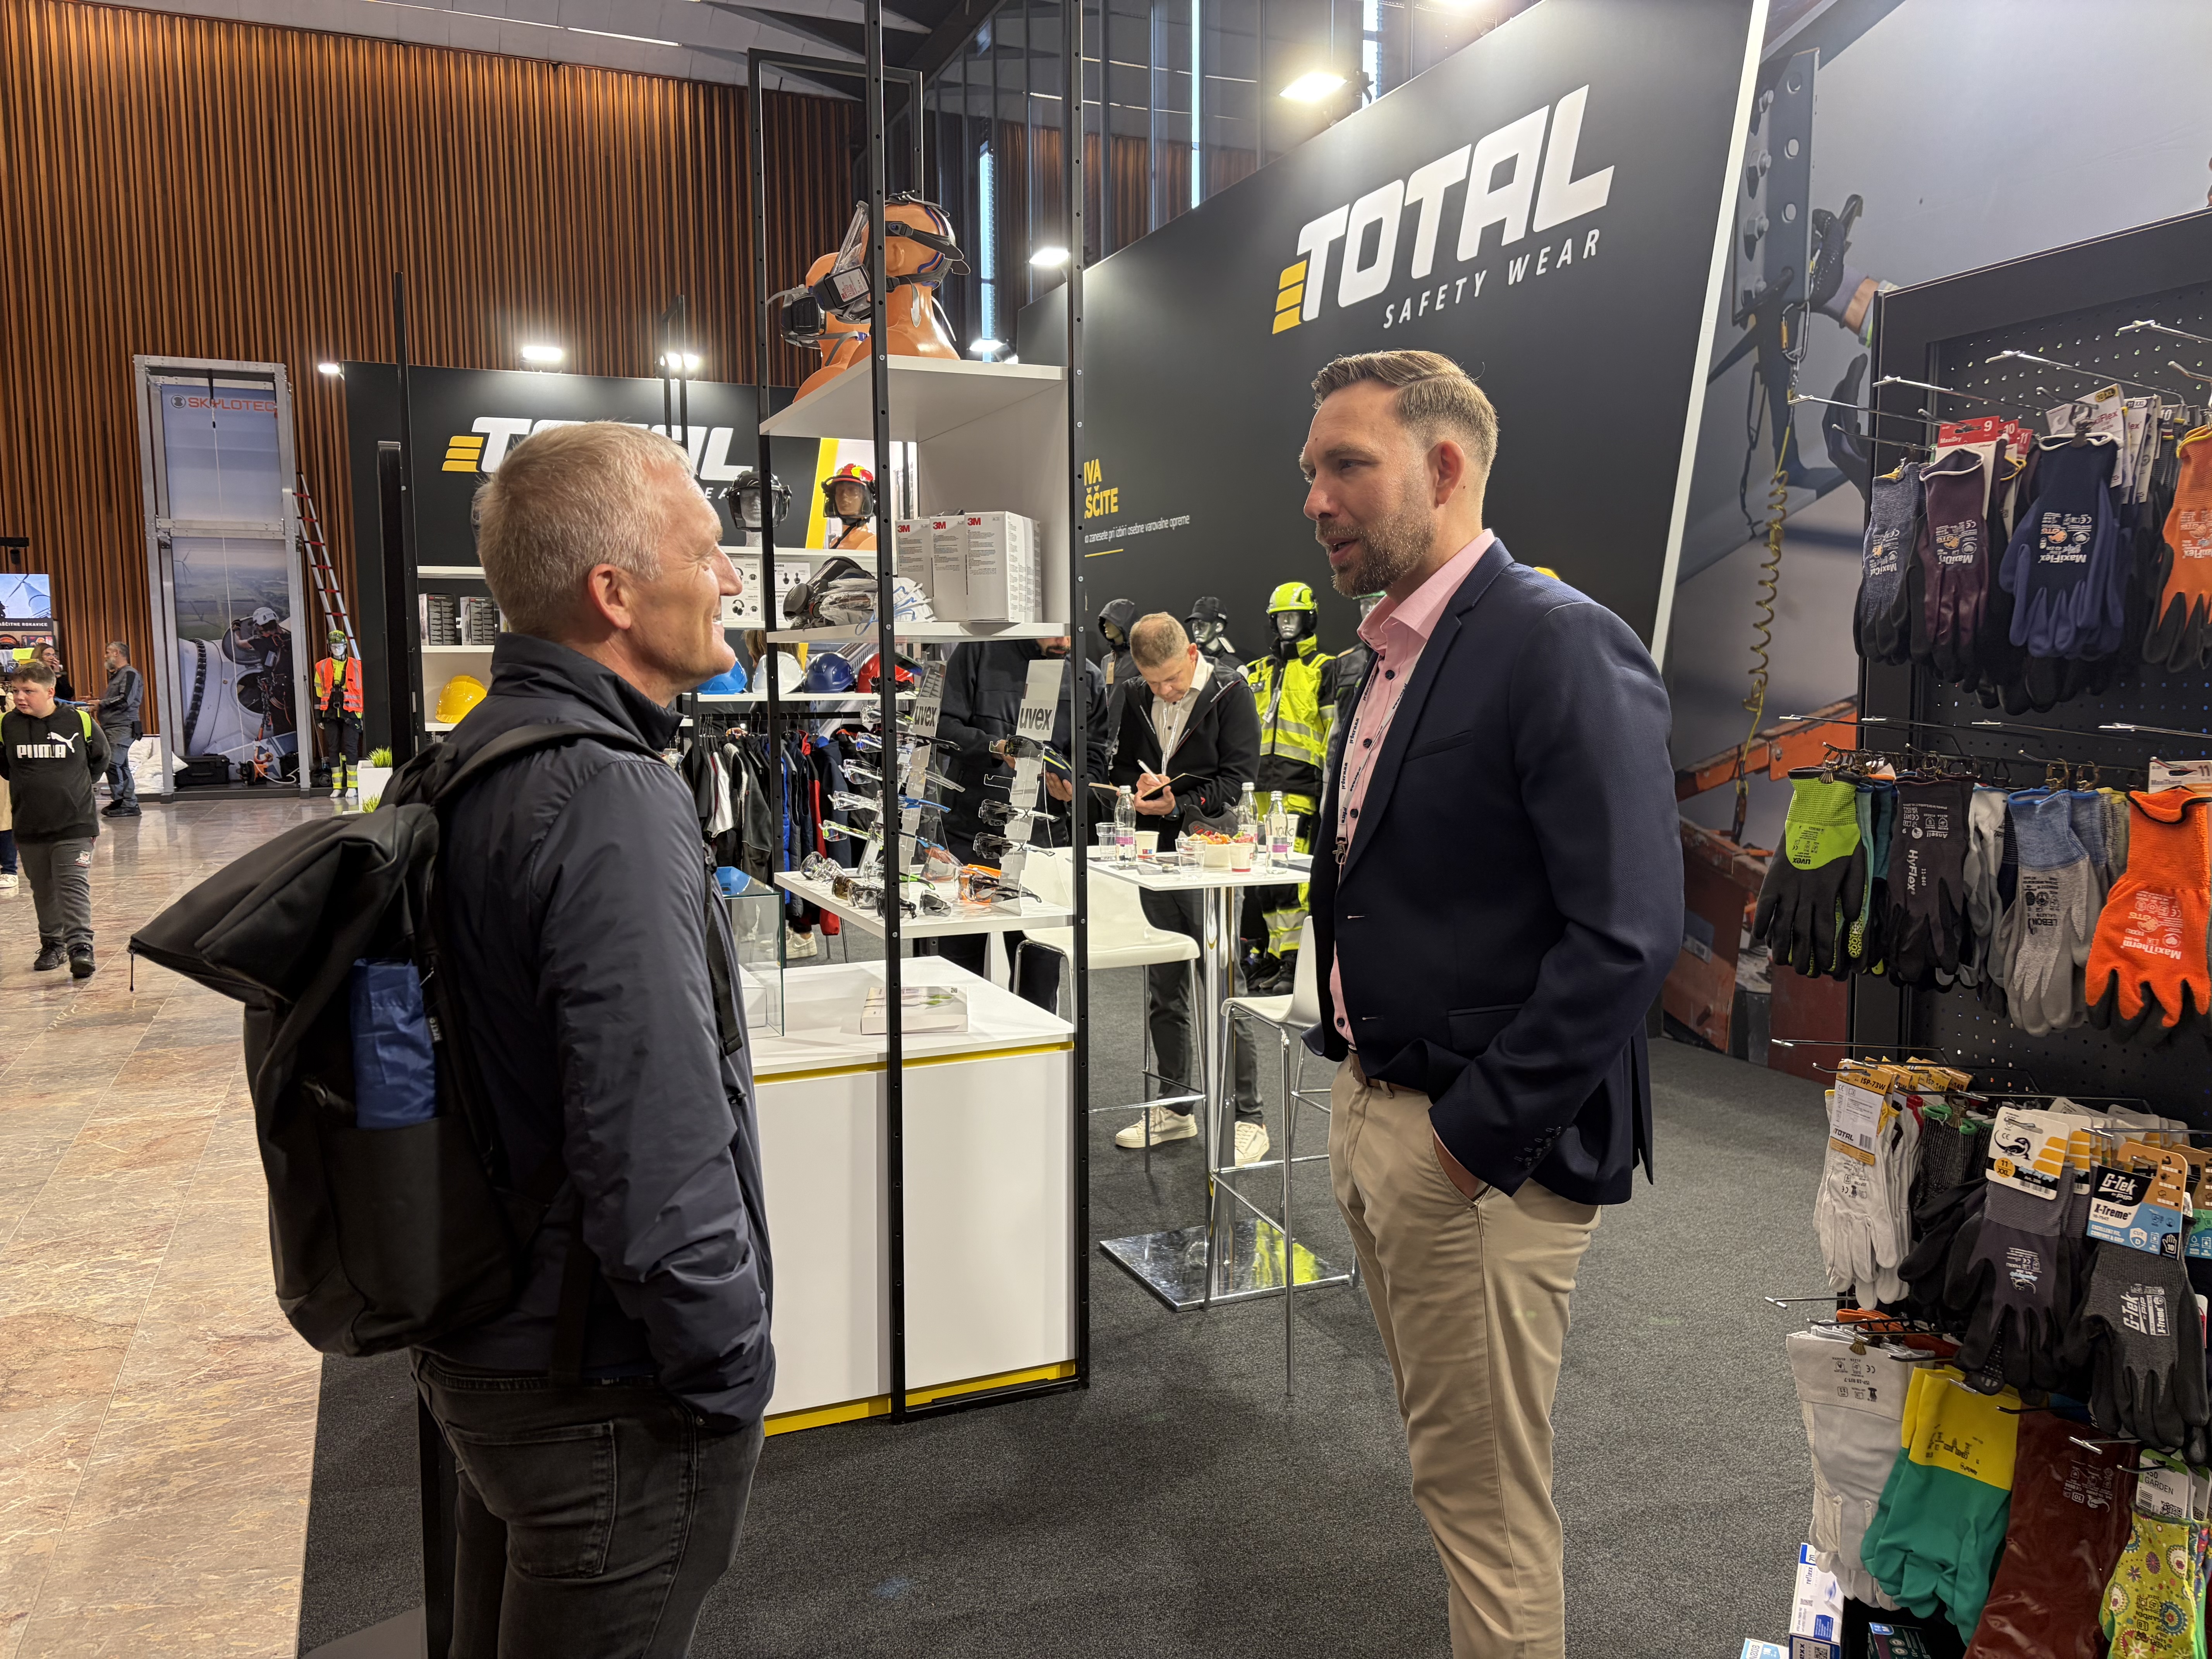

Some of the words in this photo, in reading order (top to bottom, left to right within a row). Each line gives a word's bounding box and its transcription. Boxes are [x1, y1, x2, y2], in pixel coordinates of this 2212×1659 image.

[1297, 84, 1615, 322] TOTAL
[1383, 270, 1487, 329] SAFETY
[1508, 228, 1601, 286] WEAR
[188, 397, 276, 412] SKYLOTEC
[1984, 420, 1992, 432] 9
[2004, 423, 2015, 434] 10
[2020, 432, 2028, 444] 11
[1085, 485, 1118, 519] ŠČITE
[897, 525, 910, 533] 3M
[933, 521, 946, 530] 3M
[967, 517, 981, 526] 3M
[1127, 523, 1144, 536] osebne
[1145, 517, 1169, 532] varovalne
[1170, 515, 1190, 530] opreme
[1937, 554, 1973, 565] MaxiDry
[2038, 555, 2087, 564] MaxiFlex
[1870, 562, 1898, 577] MaxiCut
[914, 706, 937, 727] uvex
[1019, 708, 1053, 731] uvex
[16, 744, 66, 759] PUMA
[2198, 765, 2210, 776] 11
[1906, 849, 1919, 890] HyFlex
[2122, 939, 2182, 960] MaxiTherm
[1860, 1077, 1886, 1091] ISP-73W
[1834, 1128, 1854, 1141] TOTAL
[2101, 1173, 2138, 1195] G-Tek
[2094, 1204, 2128, 1220] X-Treme
[2120, 1294, 2140, 1331] G-Tek
[2146, 1471, 2158, 1479] 50
[2145, 1476, 2174, 1495] GARDEN
